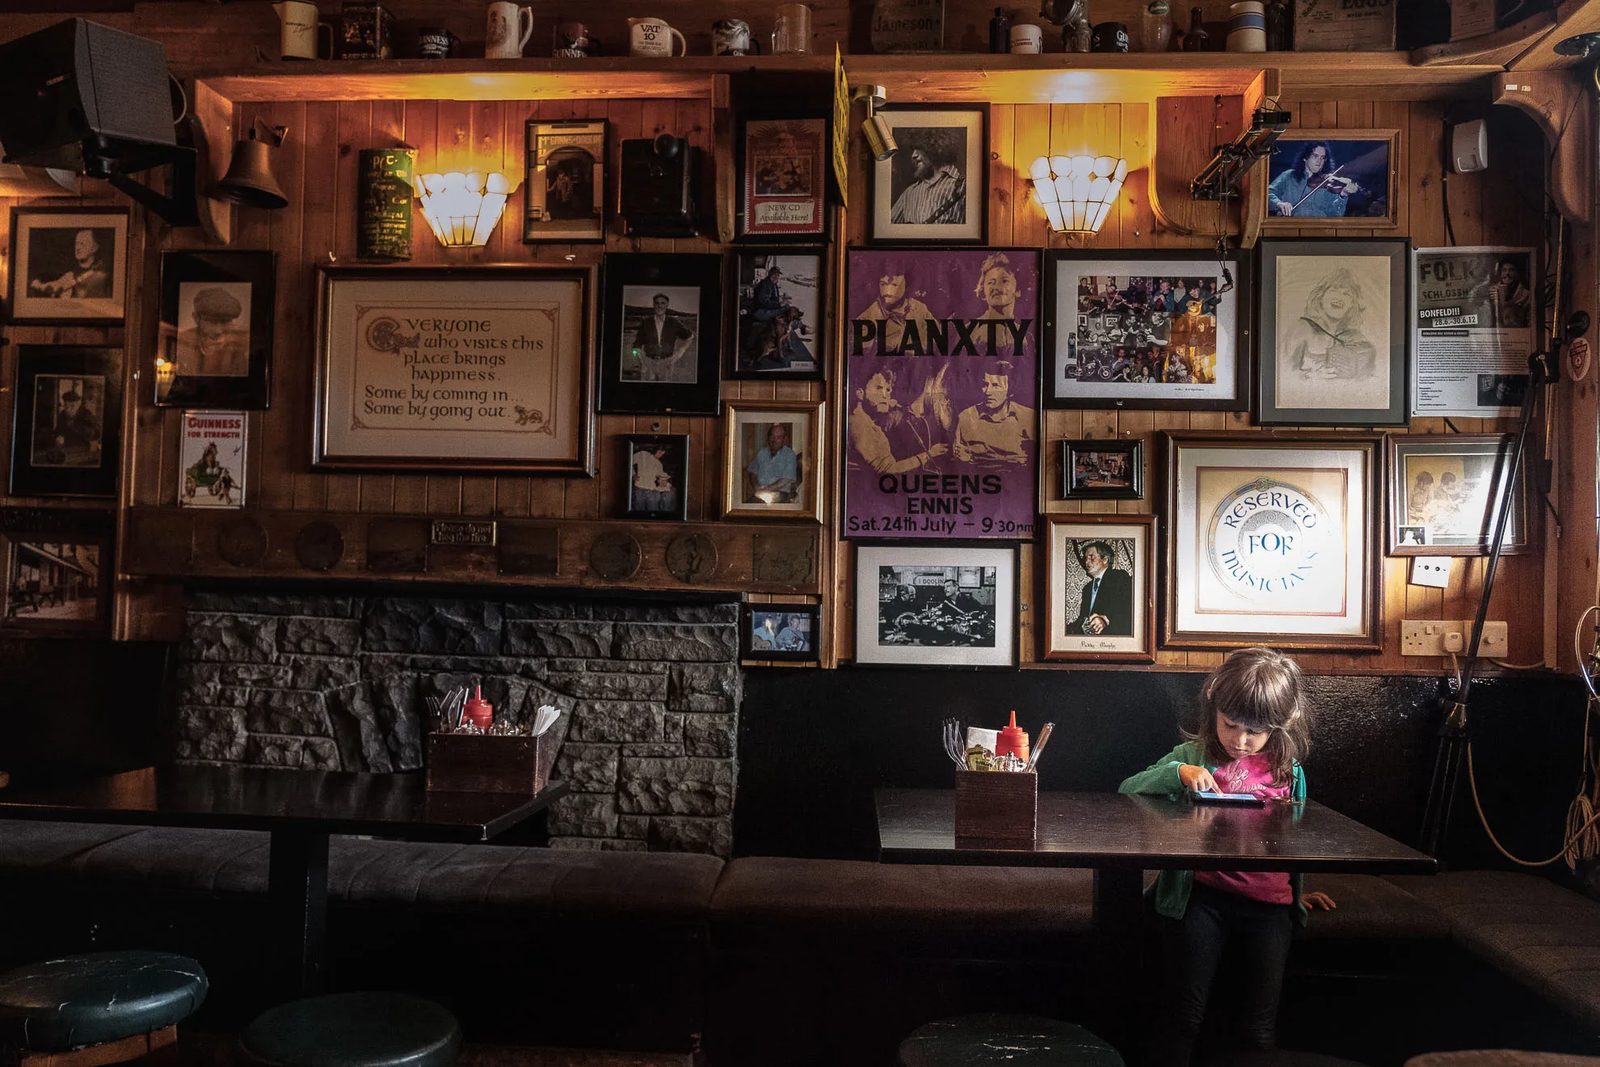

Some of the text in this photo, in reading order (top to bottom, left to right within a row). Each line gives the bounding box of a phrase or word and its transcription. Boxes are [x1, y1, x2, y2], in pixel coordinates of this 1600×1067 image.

[640, 24, 660, 32] VAT
[768, 204, 801, 212] NEW CD
[423, 333, 544, 351] who visits this
[850, 318, 1034, 357] PLANXTY
[364, 384, 407, 400] Some
[411, 384, 429, 403] by
[433, 388, 488, 404] coming
[363, 400, 404, 416] Some
[408, 400, 427, 421] by
[429, 405, 473, 422] going
[187, 416, 241, 429] GUINNESS
[187, 430, 240, 439] FOR STRENGTH
[878, 473, 1003, 495] QUEENS
[907, 496, 974, 515] ENNIS
[1223, 490, 1317, 529] RESERVED
[920, 516, 957, 535] July
[1248, 532, 1294, 556] FOR
